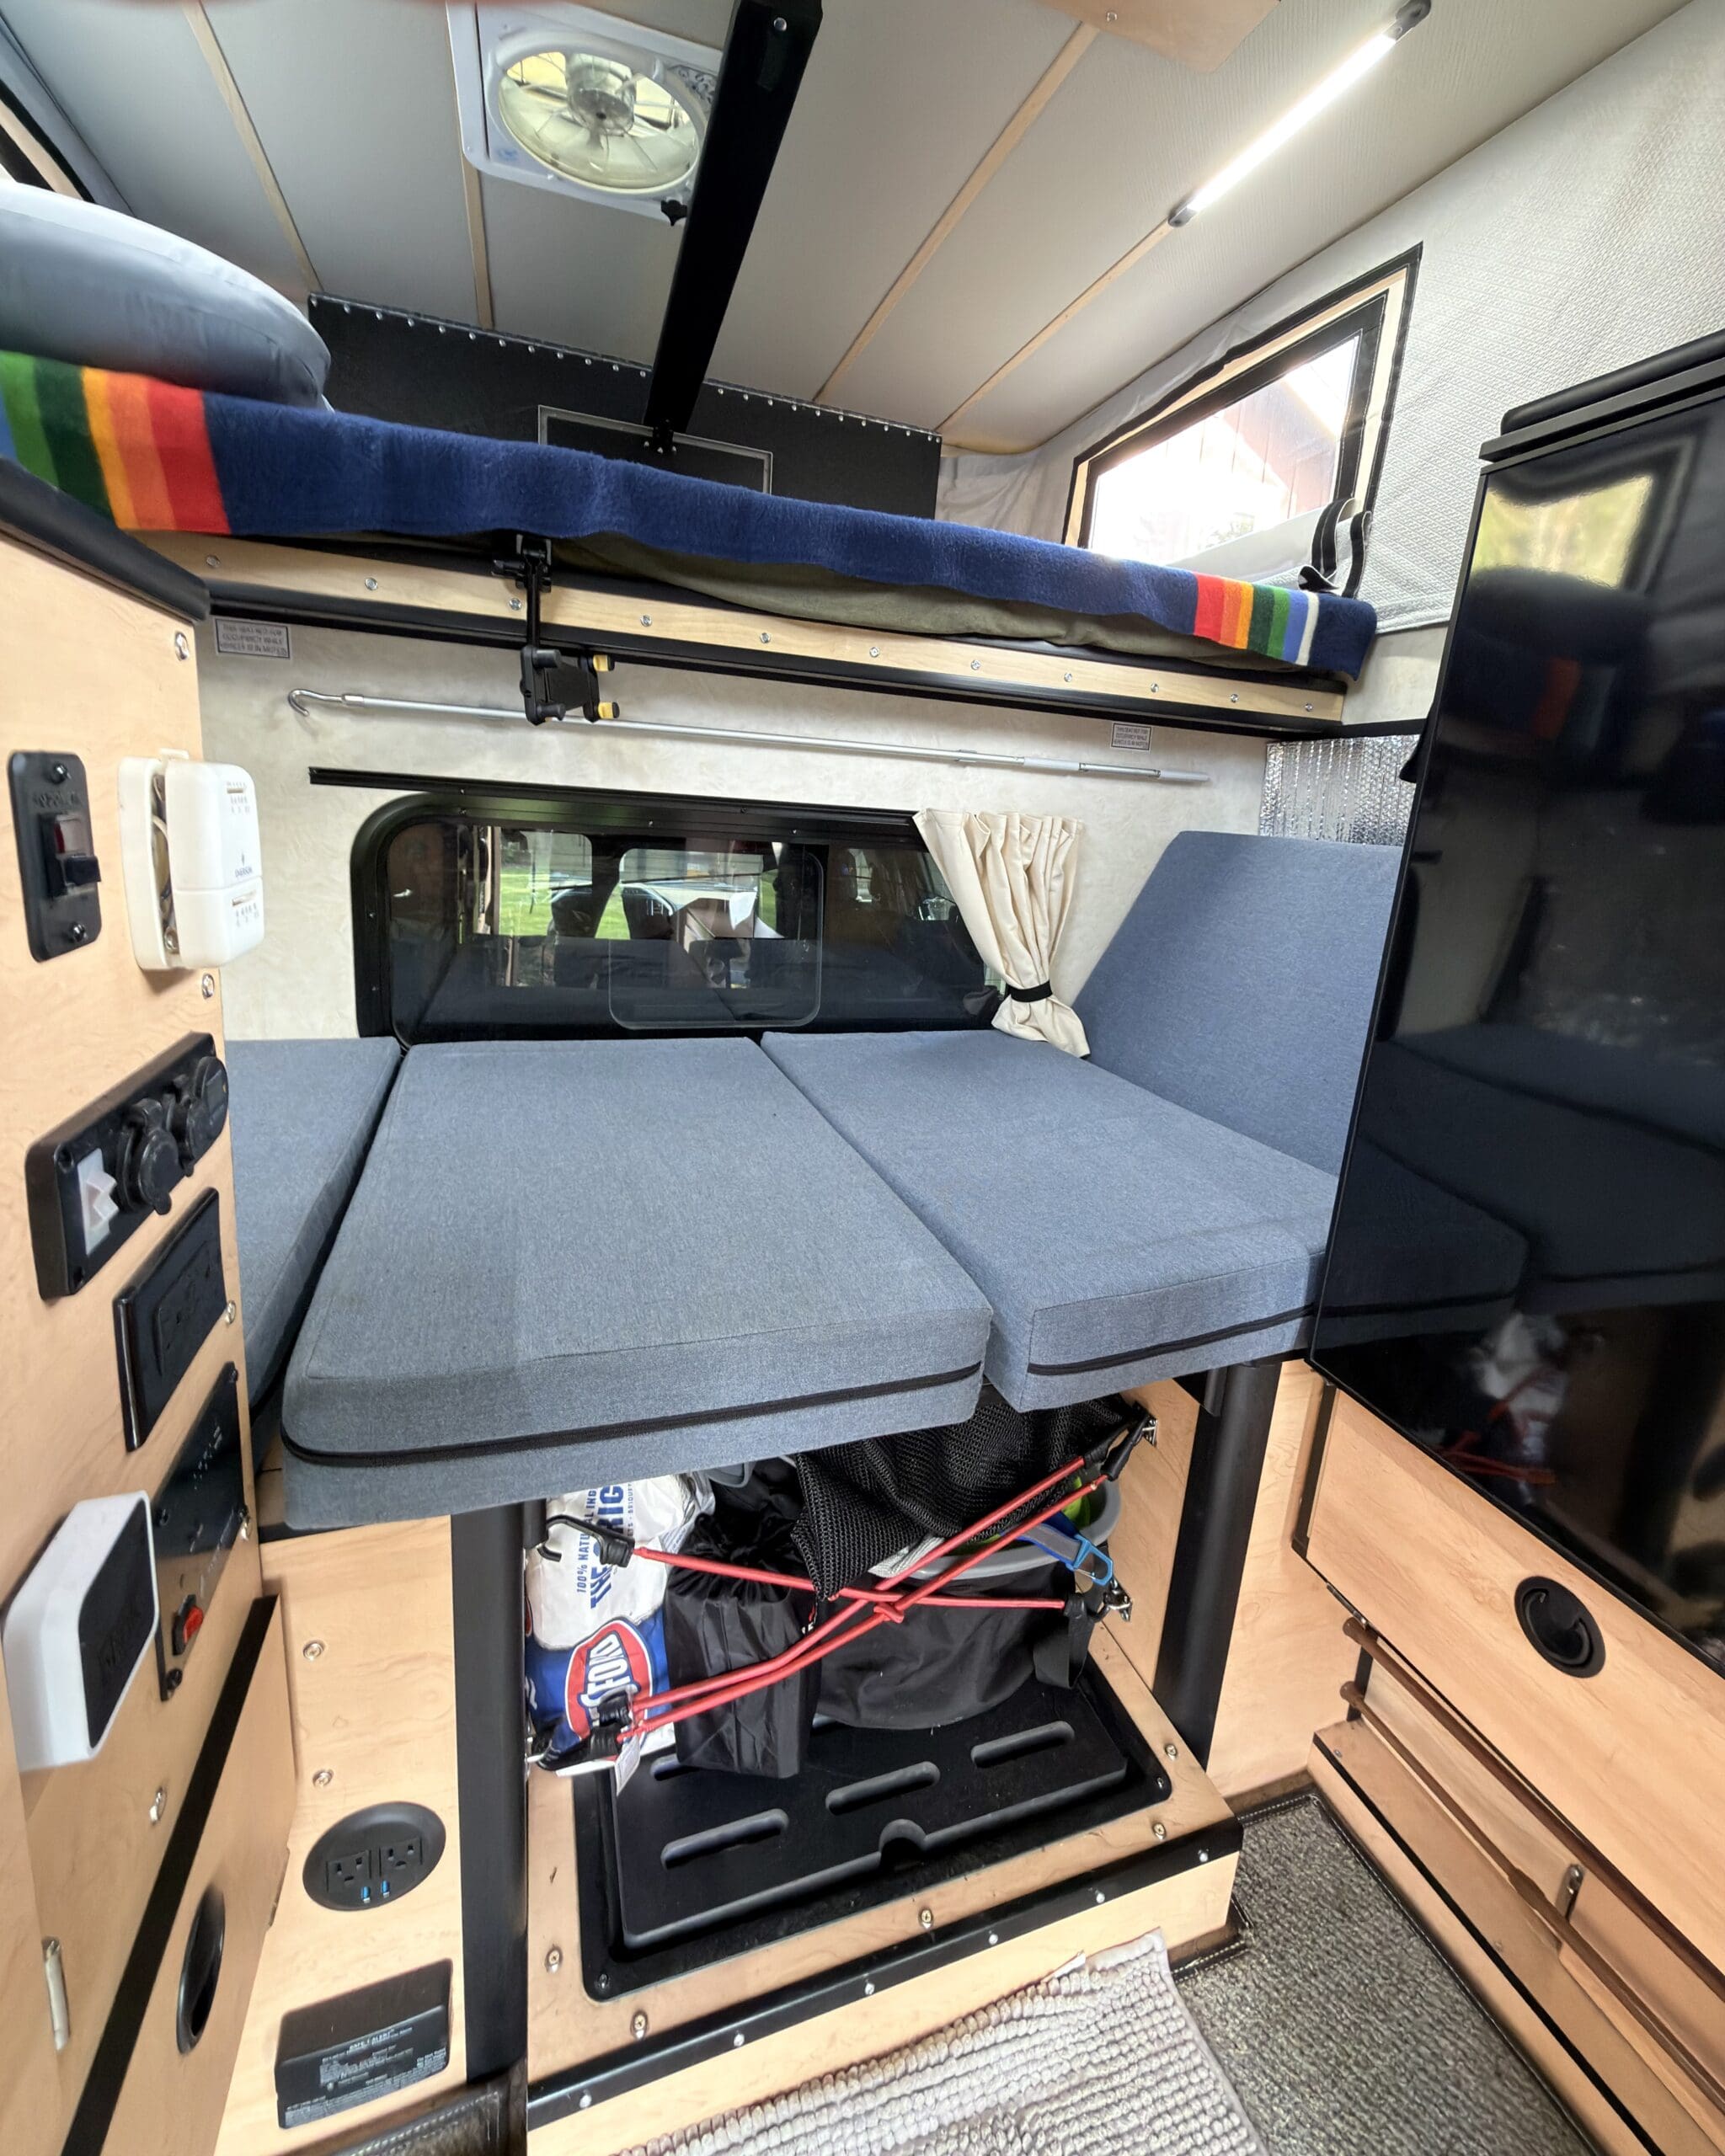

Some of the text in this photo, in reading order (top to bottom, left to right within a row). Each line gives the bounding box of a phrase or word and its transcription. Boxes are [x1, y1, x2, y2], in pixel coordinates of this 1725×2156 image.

[578, 1512, 595, 1561] NATUAL
[576, 1564, 588, 1593] 100%
[590, 1565, 613, 1609] THE
